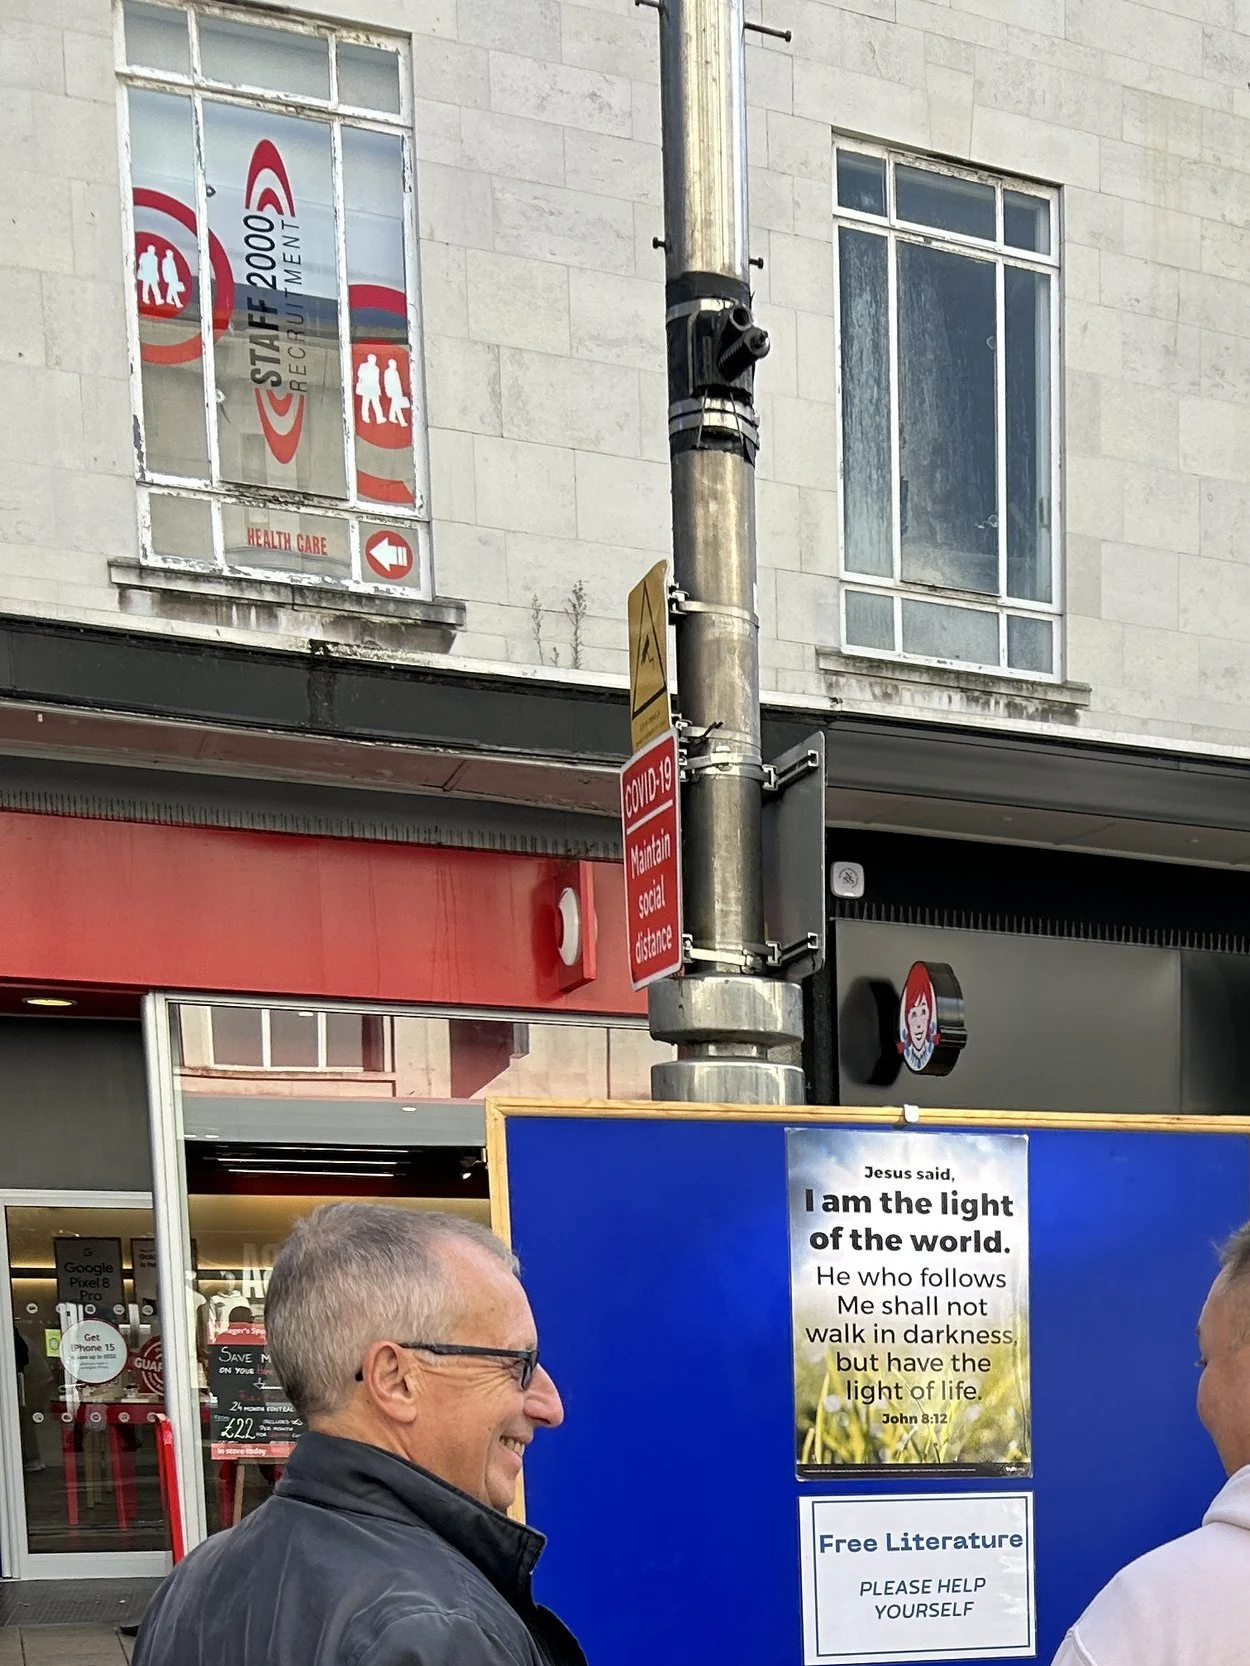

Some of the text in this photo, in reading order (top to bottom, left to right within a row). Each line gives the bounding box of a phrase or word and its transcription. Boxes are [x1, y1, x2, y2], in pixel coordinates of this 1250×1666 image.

[243, 214, 282, 388] STAFF 2000
[278, 218, 307, 393] RECRUITMENT
[246, 526, 328, 557] HEALTH CARE
[625, 756, 672, 819] COVID-19
[631, 827, 671, 880] Maintain
[639, 874, 666, 920] social
[635, 923, 672, 965] distance
[864, 1166, 956, 1183] Jesus said,
[805, 1188, 1014, 1222] I am the light
[809, 1226, 1011, 1254] of the world.
[63, 1261, 114, 1276] Google
[816, 1266, 1007, 1288] He who follows
[69, 1276, 110, 1289] Pixel 8
[79, 1289, 103, 1302] Pro
[837, 1295, 988, 1316] Me shall not
[84, 1333, 100, 1342] Get
[805, 1322, 1018, 1347] walk in darkness,
[105, 1343, 115, 1351] 15
[836, 1351, 992, 1373] but have the
[846, 1380, 982, 1404] light of life.
[220, 1417, 256, 1440] £22
[882, 1413, 948, 1425] John 8:12
[819, 1532, 1024, 1554] Free Literature
[859, 1577, 987, 1597] PLEASE HELP
[874, 1601, 975, 1620] YOURSELF
